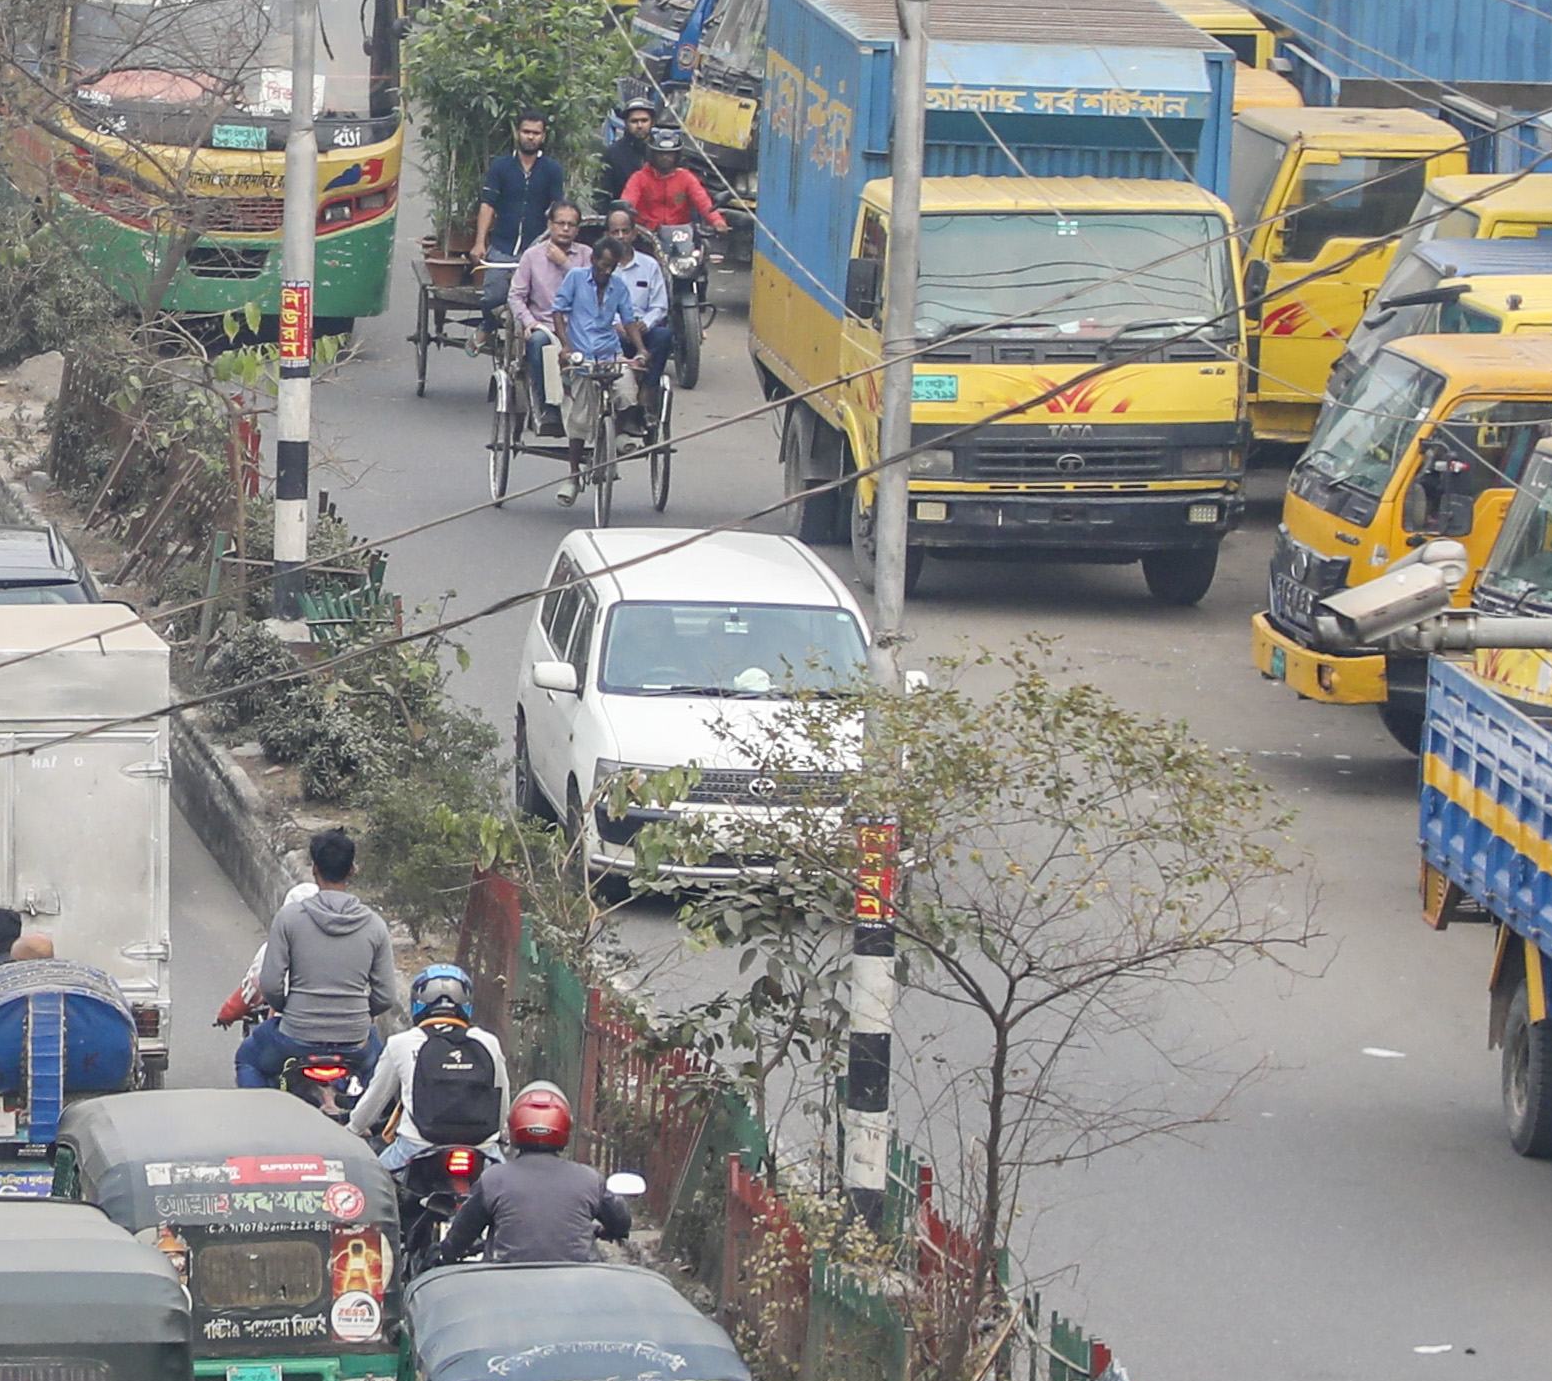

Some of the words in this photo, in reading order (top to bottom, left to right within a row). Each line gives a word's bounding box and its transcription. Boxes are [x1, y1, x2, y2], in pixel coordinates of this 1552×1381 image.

[1034, 89, 1080, 114] সর্ব
[281, 287, 302, 355] নিউরন
[1048, 424, 1094, 438] TATA
[293, 1162, 318, 1171] STAR
